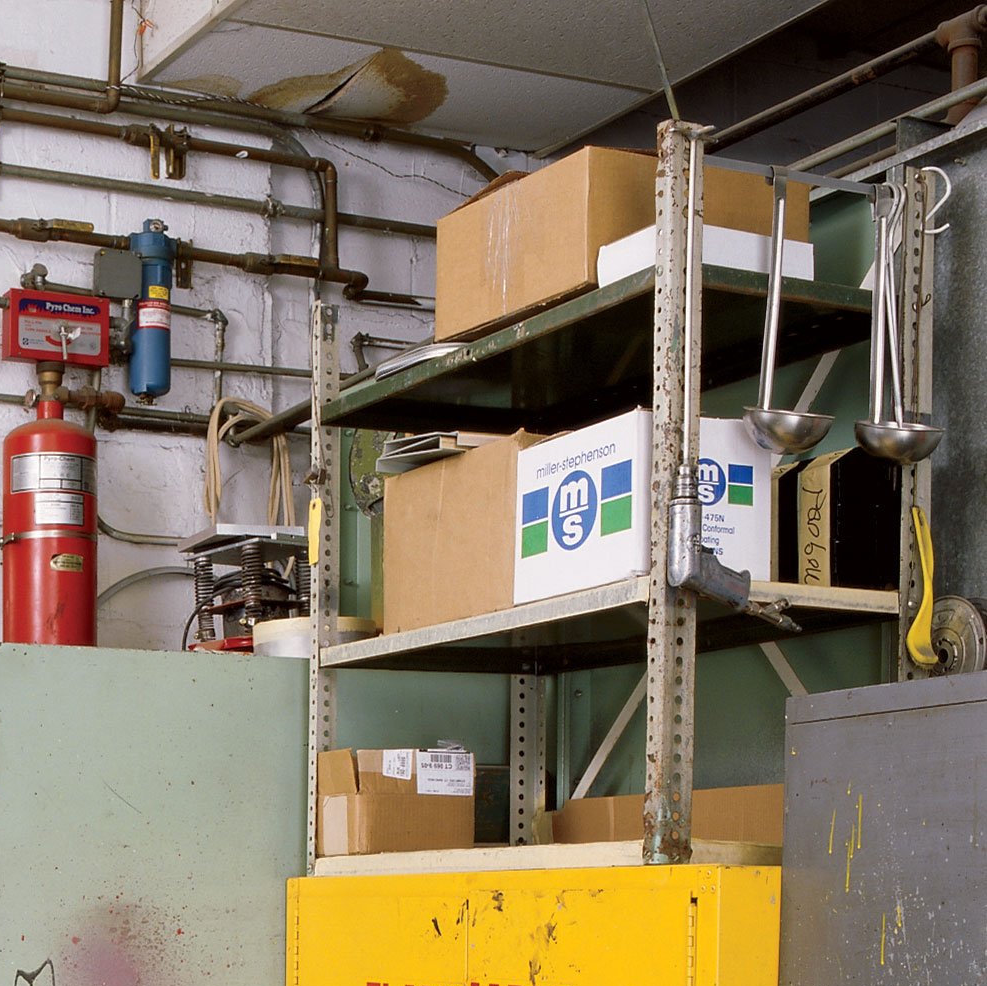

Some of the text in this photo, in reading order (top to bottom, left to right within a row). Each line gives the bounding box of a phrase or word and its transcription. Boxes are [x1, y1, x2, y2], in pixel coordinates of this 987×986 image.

[46, 302, 95, 314] Pyro Chem Inc.
[537, 442, 616, 480] miller-stephenson
[702, 524, 735, 534] Conformal
[700, 536, 719, 546] oating
